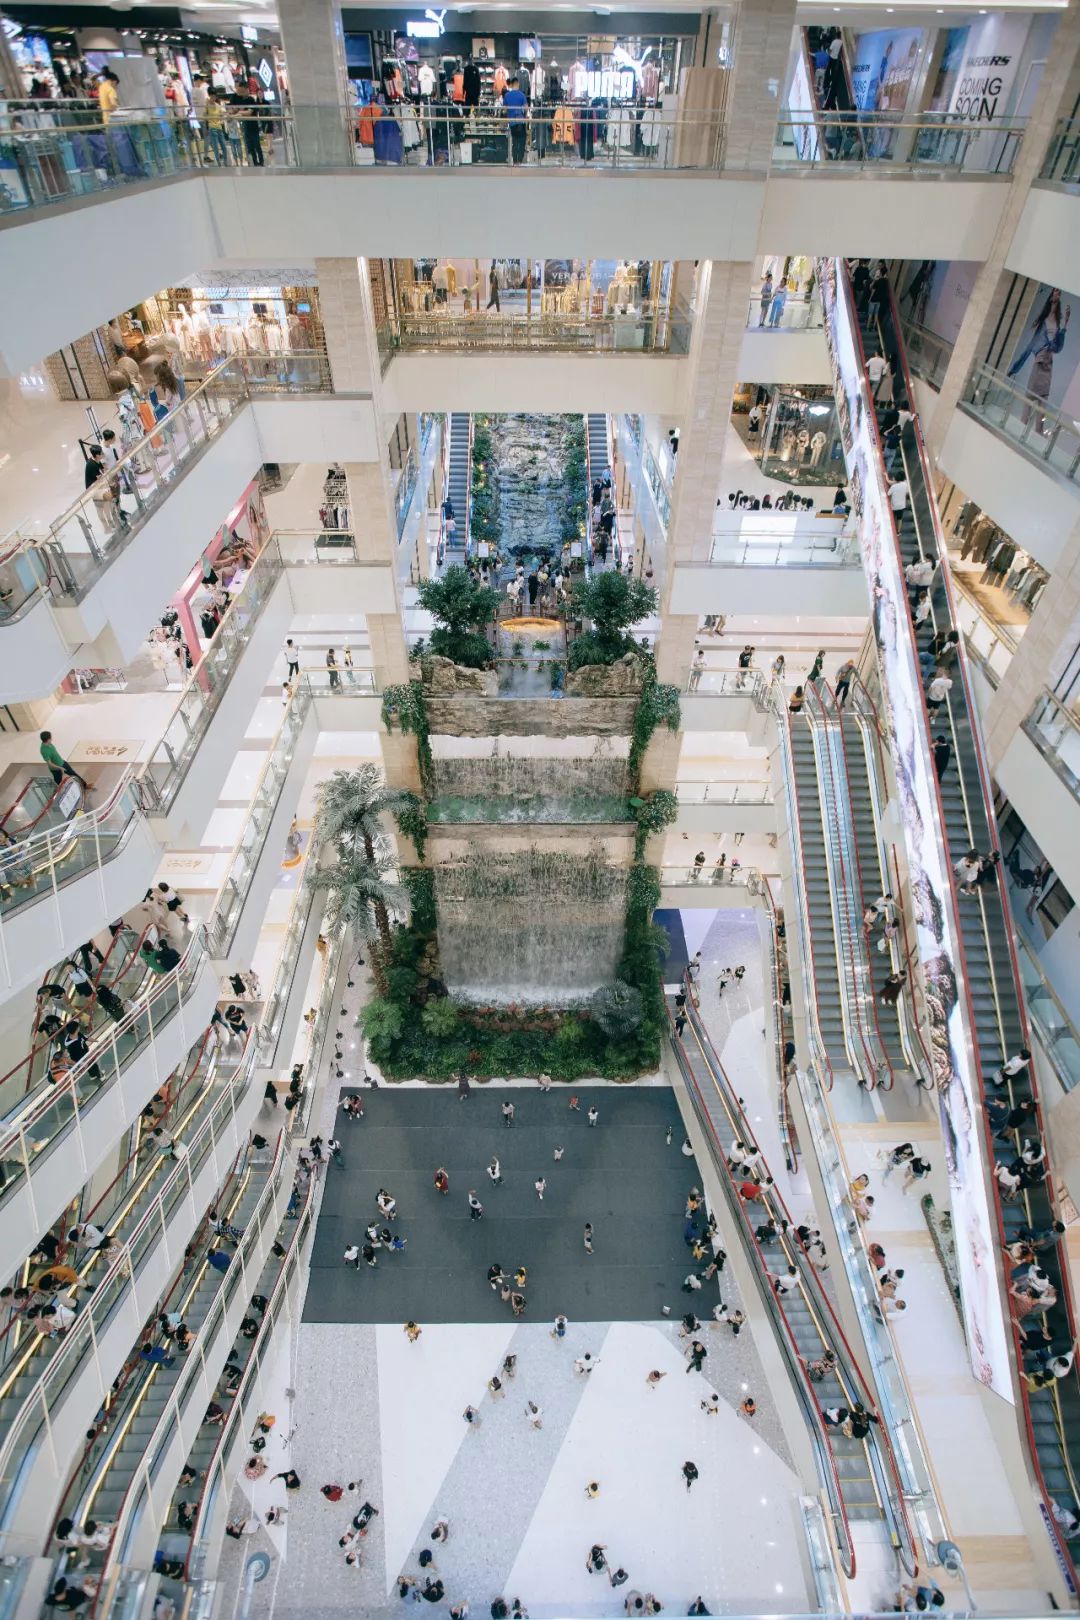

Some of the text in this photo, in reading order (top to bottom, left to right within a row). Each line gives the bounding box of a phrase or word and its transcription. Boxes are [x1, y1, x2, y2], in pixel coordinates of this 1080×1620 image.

[575, 71, 635, 98] PUMA
[960, 78, 1002, 96] COMING
[954, 97, 998, 122] SOON
